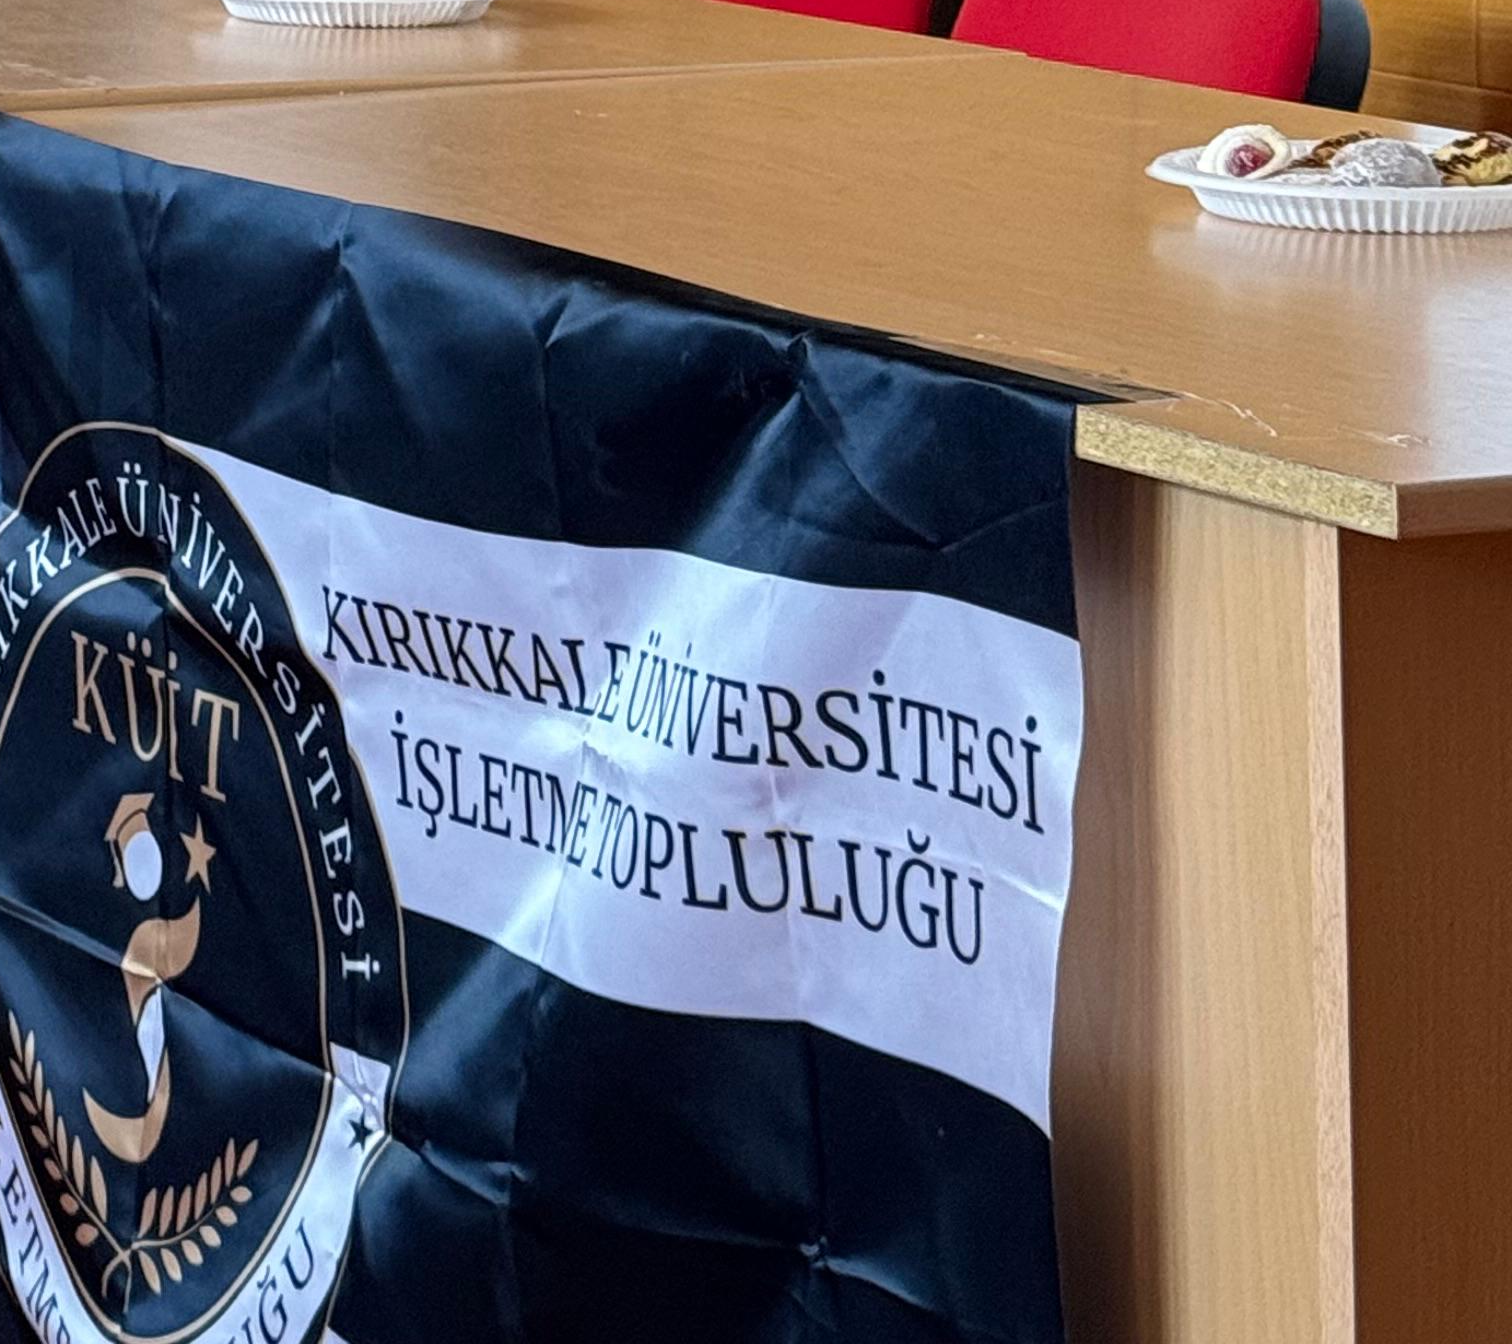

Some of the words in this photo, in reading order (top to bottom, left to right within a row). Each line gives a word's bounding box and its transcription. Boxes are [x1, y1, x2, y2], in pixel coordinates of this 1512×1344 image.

[70, 630, 241, 803] KÜİT
[116, 460, 381, 982] ÜNİVERSİTESİ
[322, 584, 631, 723] KIRIKKALE
[626, 629, 1044, 835] ÜNİVERSİTESİ
[591, 793, 985, 965] TOPLULUĞU
